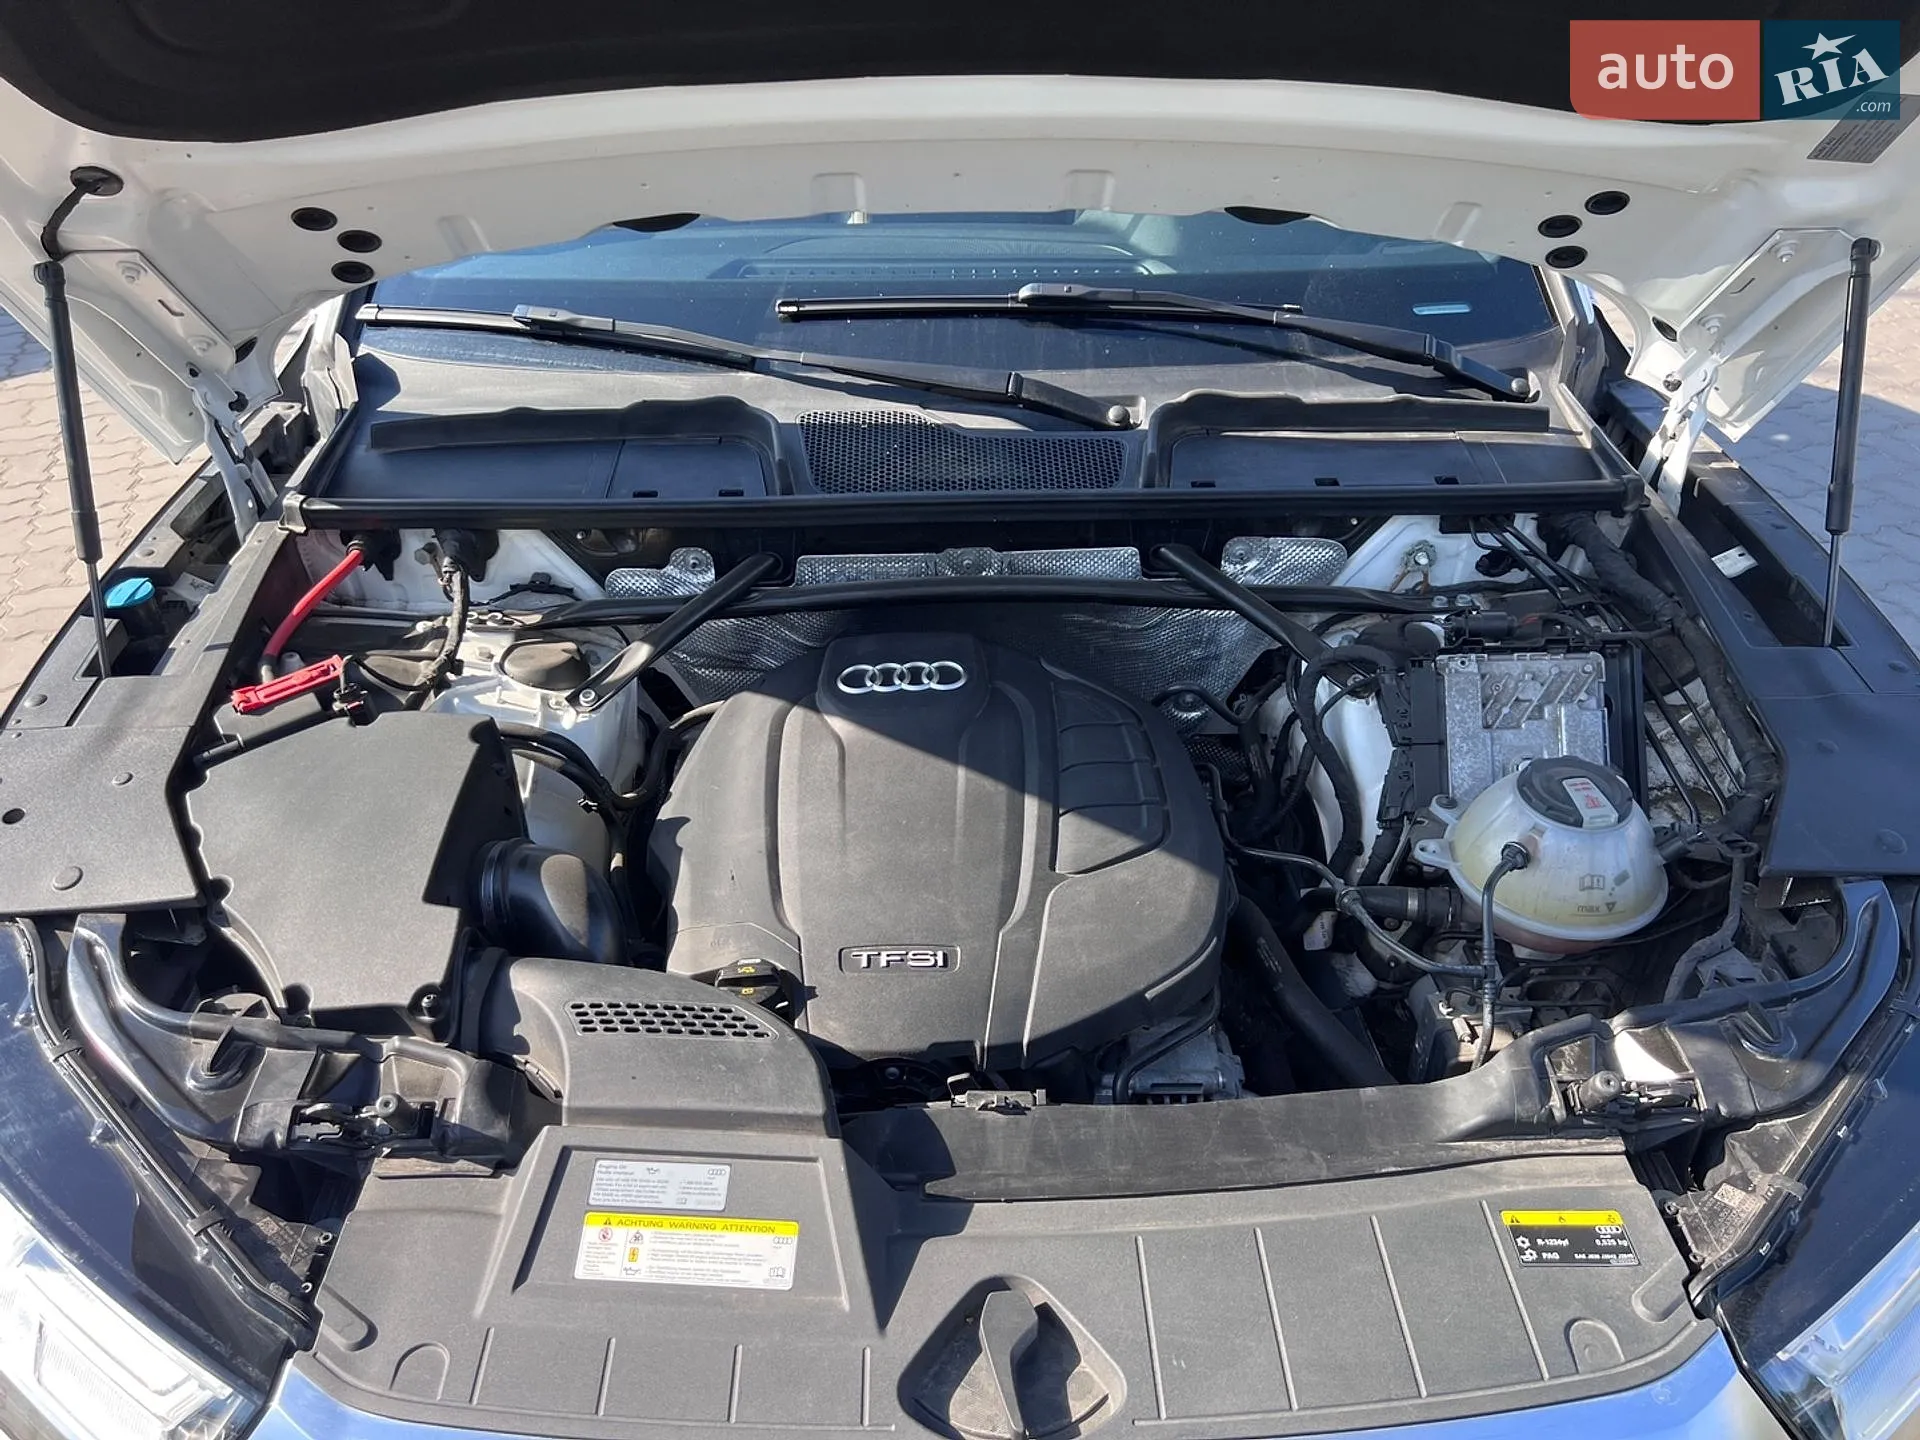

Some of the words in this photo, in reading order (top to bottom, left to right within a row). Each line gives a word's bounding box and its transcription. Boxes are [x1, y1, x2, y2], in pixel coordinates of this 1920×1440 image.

[851, 950, 948, 968] TFSI
[617, 1218, 664, 1229] ACHTUNG
[669, 1220, 717, 1231] WARNING
[721, 1223, 777, 1234] ATTENTION
